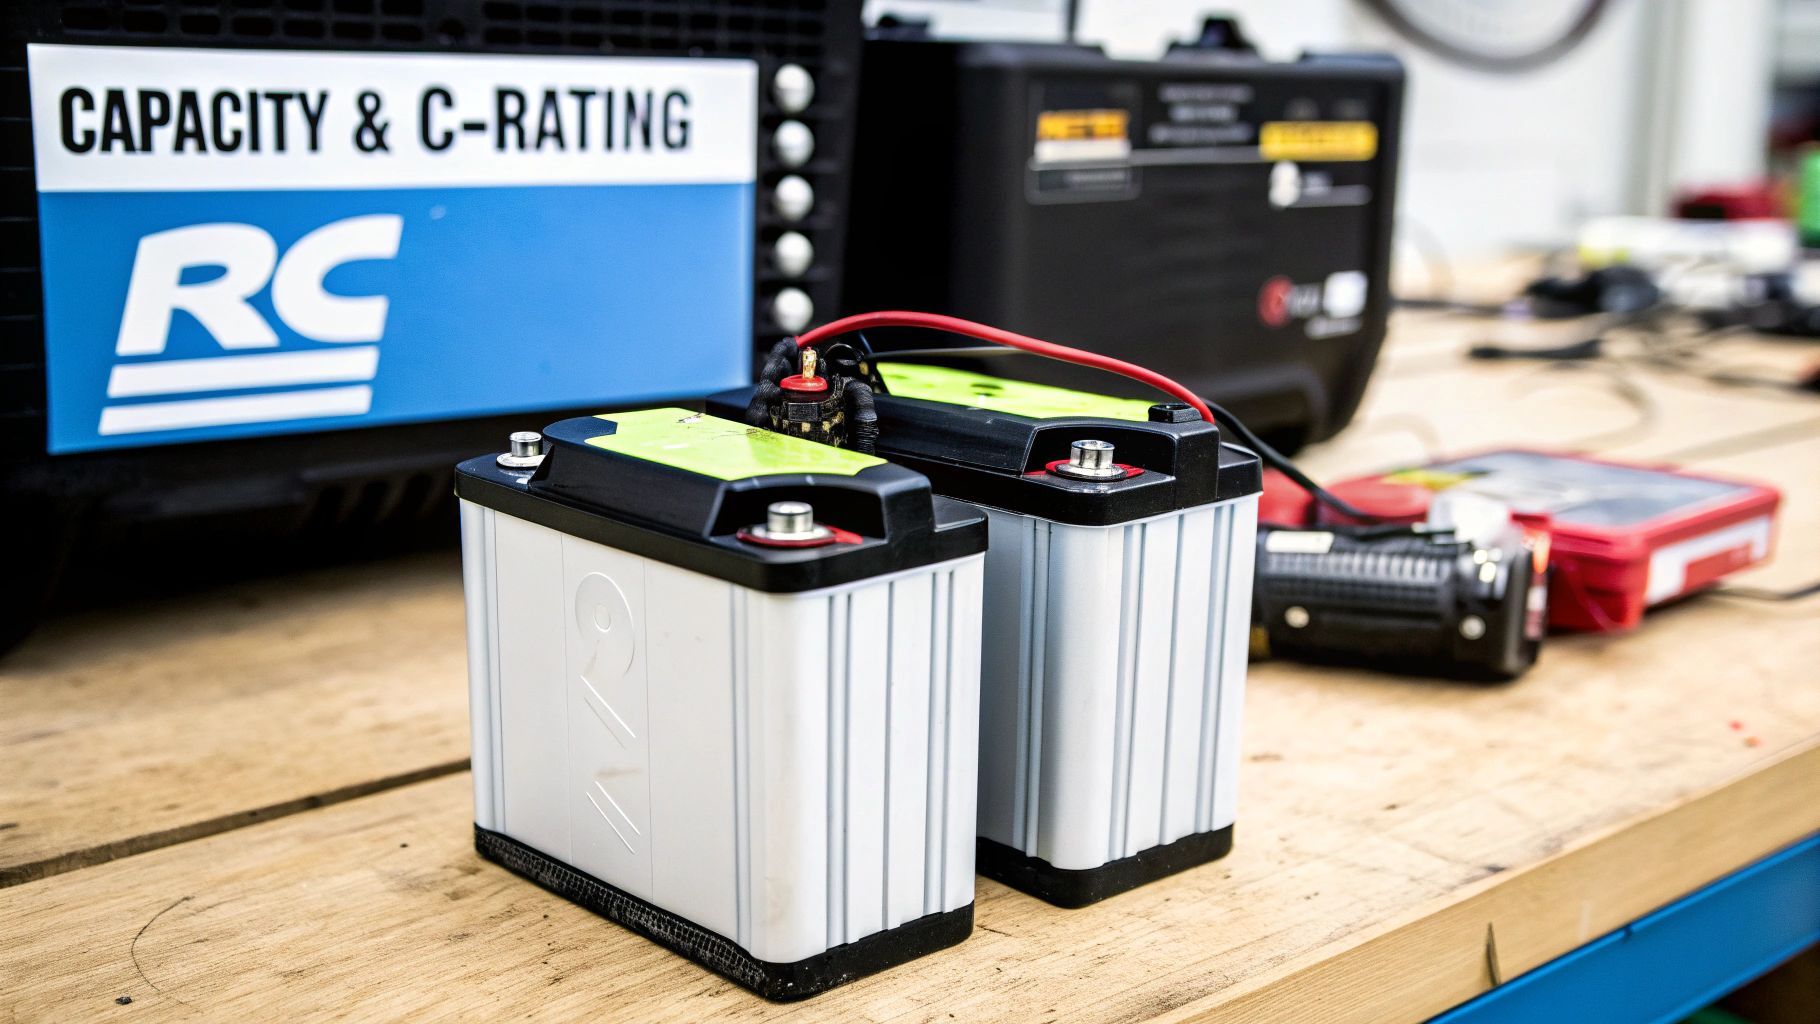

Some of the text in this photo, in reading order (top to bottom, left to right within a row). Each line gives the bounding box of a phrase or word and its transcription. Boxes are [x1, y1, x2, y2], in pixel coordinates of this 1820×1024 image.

[60, 86, 690, 154] CAPACITY & C-RATING
[115, 213, 404, 356] RC
